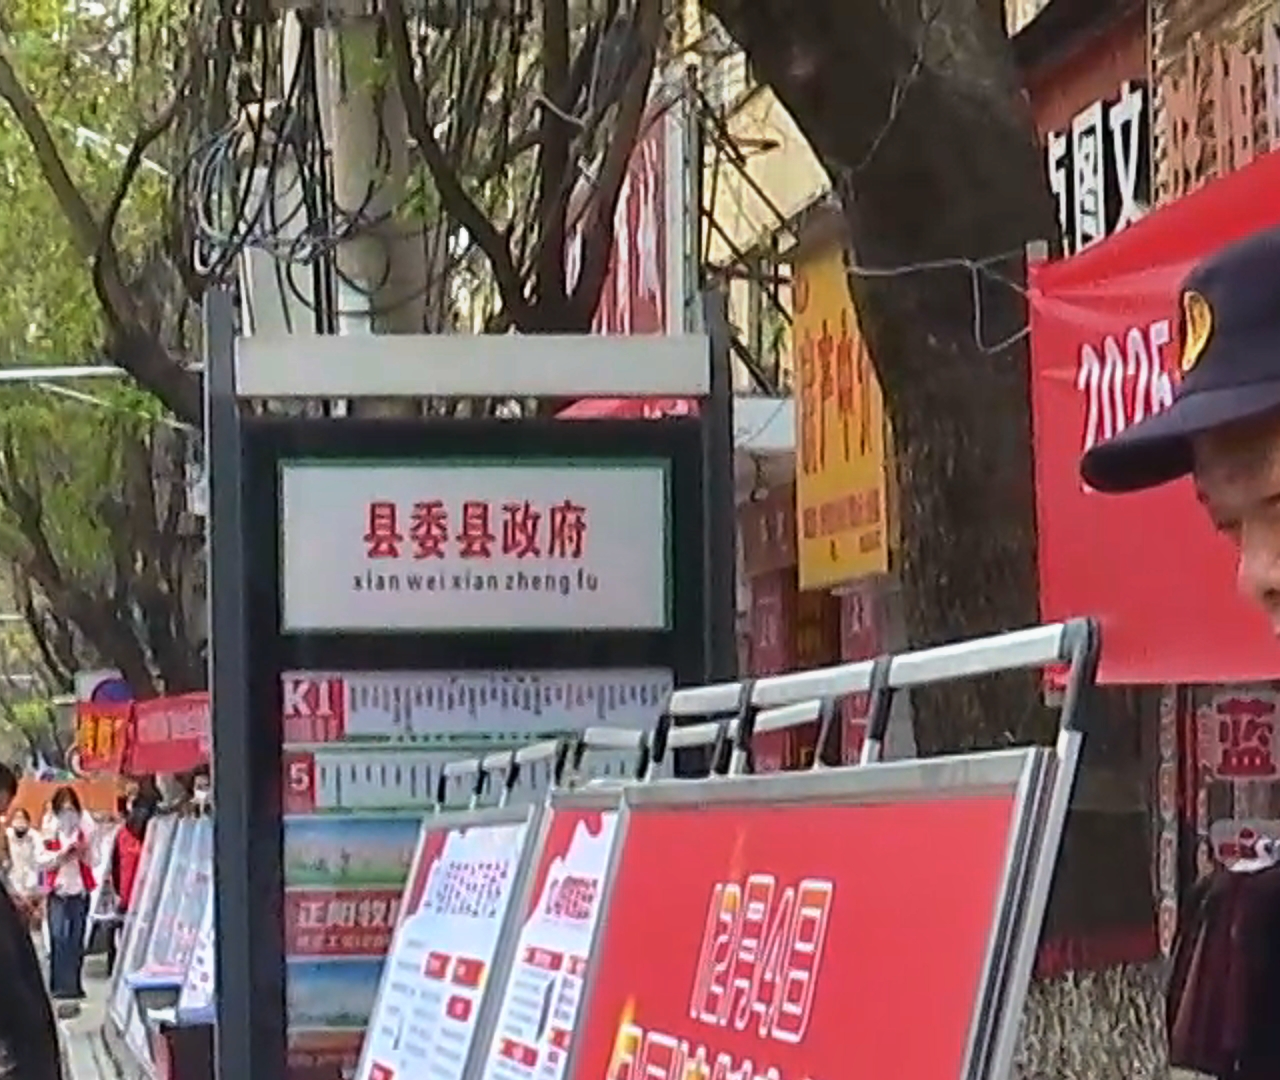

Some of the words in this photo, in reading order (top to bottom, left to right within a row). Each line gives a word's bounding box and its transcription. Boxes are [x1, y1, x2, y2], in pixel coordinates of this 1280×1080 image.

[363, 500, 587, 558] 县委县政府
[353, 568, 400, 592] xian
[407, 571, 446, 592] wei
[452, 568, 499, 592] xian
[505, 567, 570, 595] zheng
[576, 567, 599, 592] fu
[289, 762, 309, 791] 5
